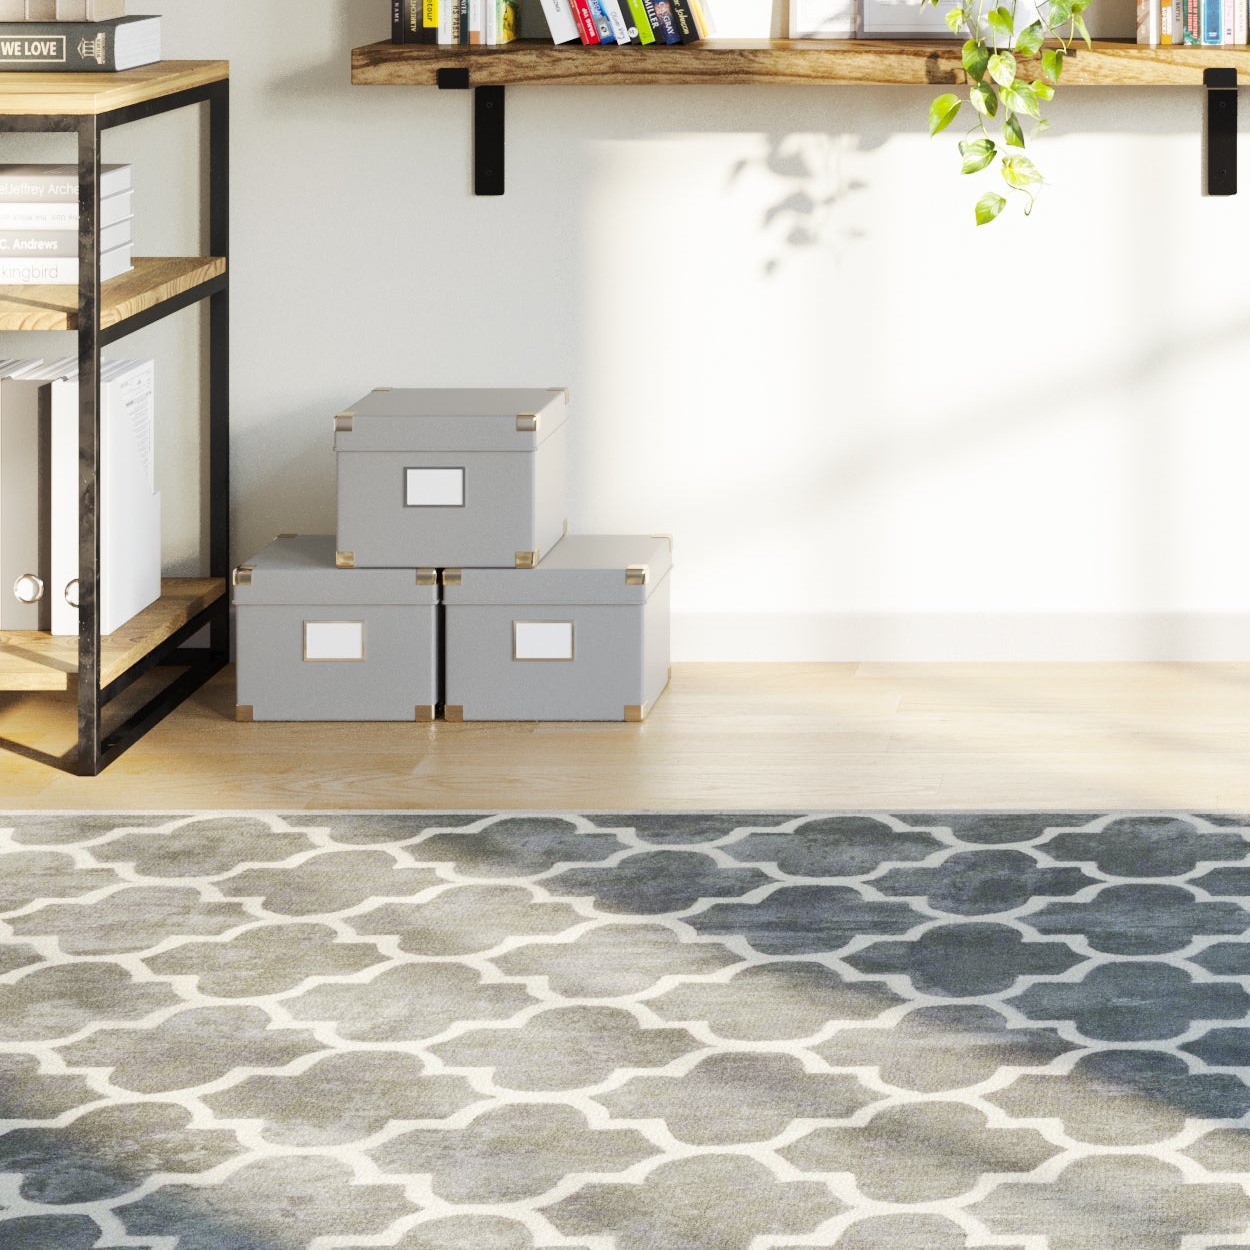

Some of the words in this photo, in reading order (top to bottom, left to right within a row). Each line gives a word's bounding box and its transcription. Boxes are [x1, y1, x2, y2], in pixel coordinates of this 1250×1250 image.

[1, 41, 22, 55] WE
[24, 41, 56, 55] LOVE
[48, 185, 79, 195] Arche
[12, 239, 58, 250] Andrews
